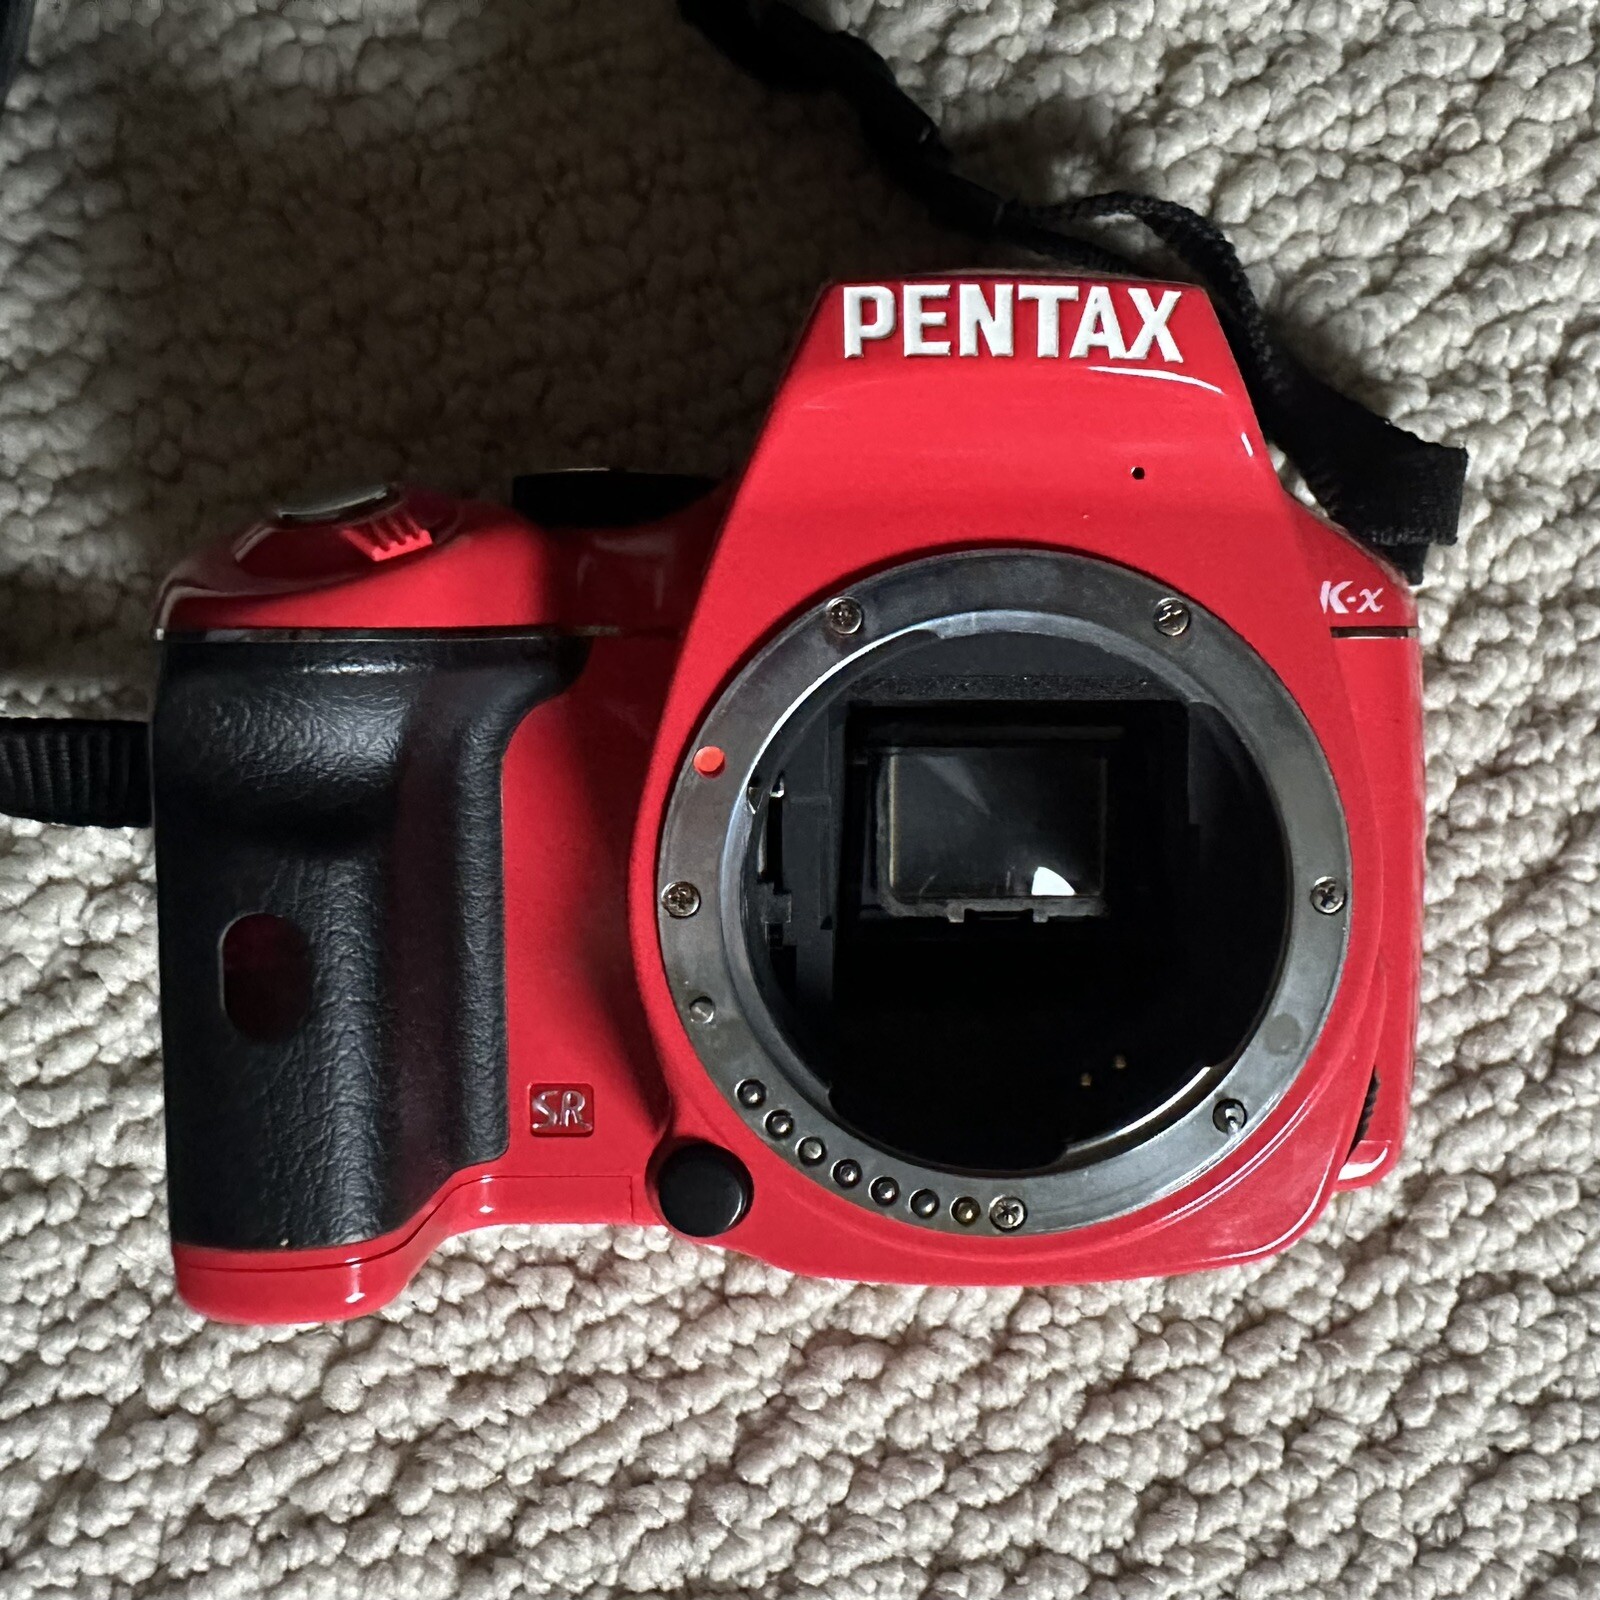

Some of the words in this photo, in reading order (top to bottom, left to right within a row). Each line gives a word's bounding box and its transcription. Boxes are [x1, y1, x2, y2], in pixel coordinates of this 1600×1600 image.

[843, 283, 1184, 363] PENTAX
[1320, 580, 1384, 614] K-x
[532, 1090, 593, 1131] SR
